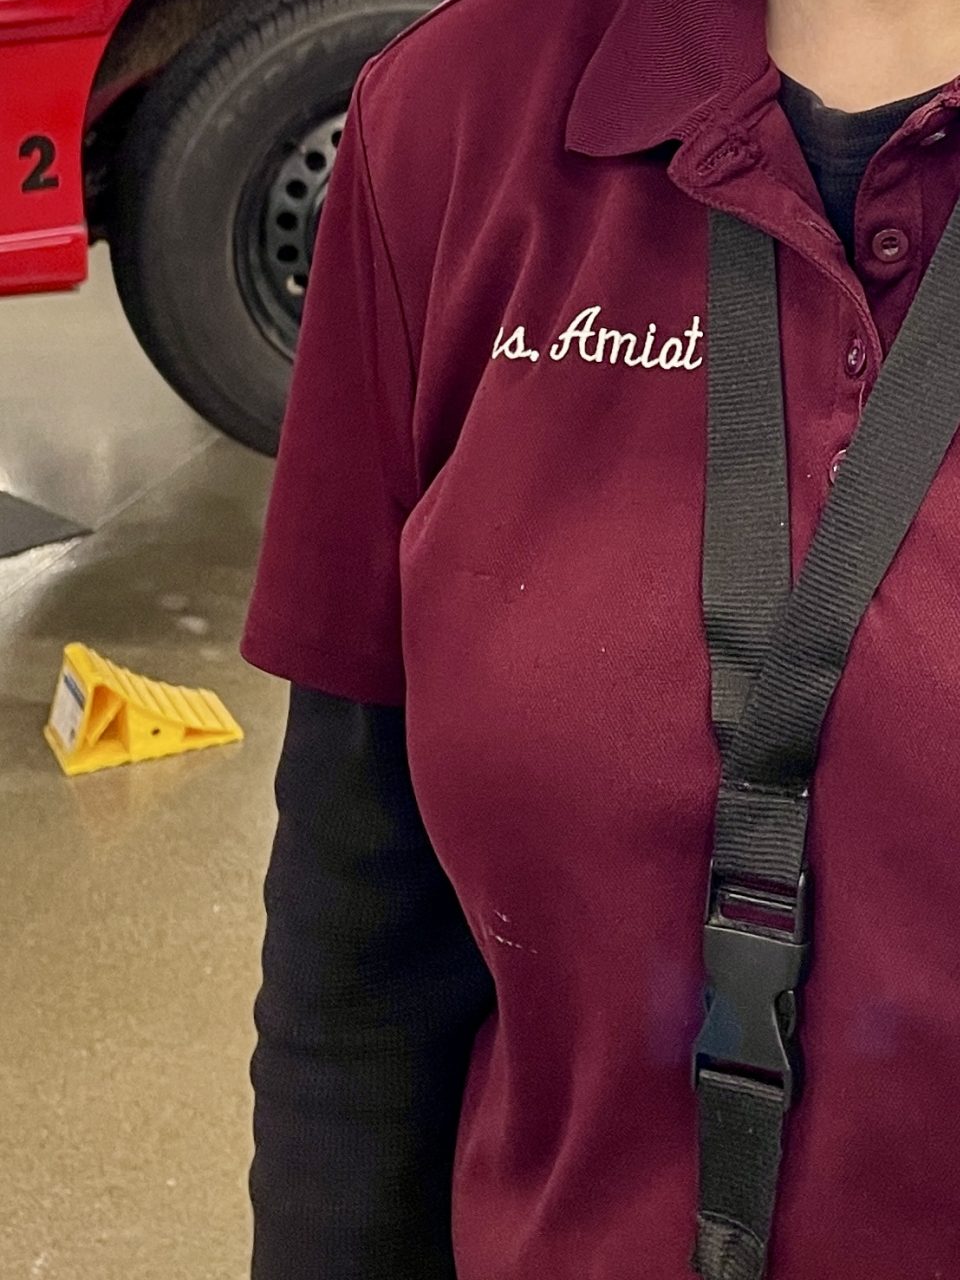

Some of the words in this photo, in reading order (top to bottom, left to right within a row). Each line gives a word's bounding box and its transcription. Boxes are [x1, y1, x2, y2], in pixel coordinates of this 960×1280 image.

[19, 135, 59, 192] 2
[491, 325, 540, 362] s.
[549, 305, 704, 370] Amiot
